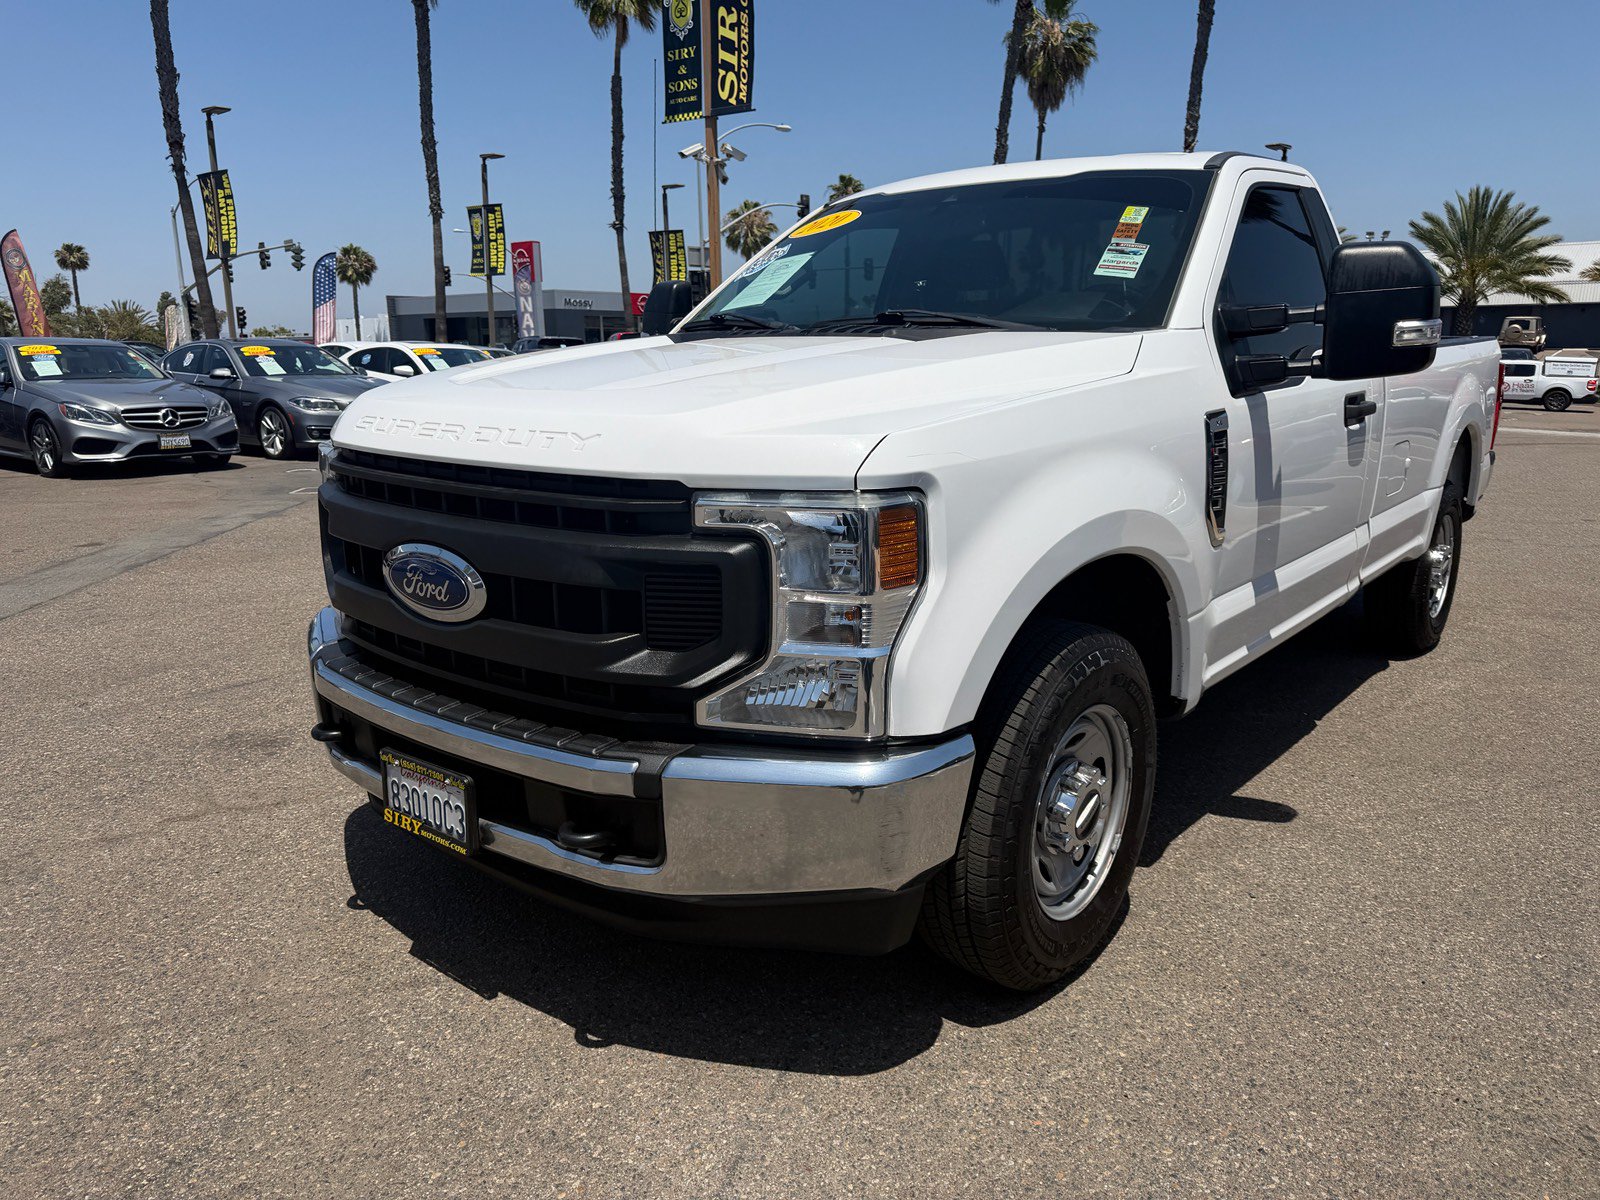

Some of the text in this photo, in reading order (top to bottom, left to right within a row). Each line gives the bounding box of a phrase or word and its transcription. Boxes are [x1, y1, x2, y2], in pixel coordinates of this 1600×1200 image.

[667, 46, 697, 62] SIRY
[677, 64, 687, 75] &
[668, 78, 698, 93] SONS
[217, 189, 229, 242] ANYONE
[221, 173, 237, 255] WE FINANCE
[487, 213, 498, 268] AUTO CARE
[494, 206, 505, 274] FULL SERVICE
[669, 233, 677, 252] OUR
[676, 233, 684, 247] WE
[563, 297, 593, 310] Mossy
[354, 415, 602, 452] SUPER DUTY
[403, 563, 450, 602] Ford
[391, 778, 466, 840] 83010C3
[383, 808, 467, 855] SIRY MOTORS.COM
